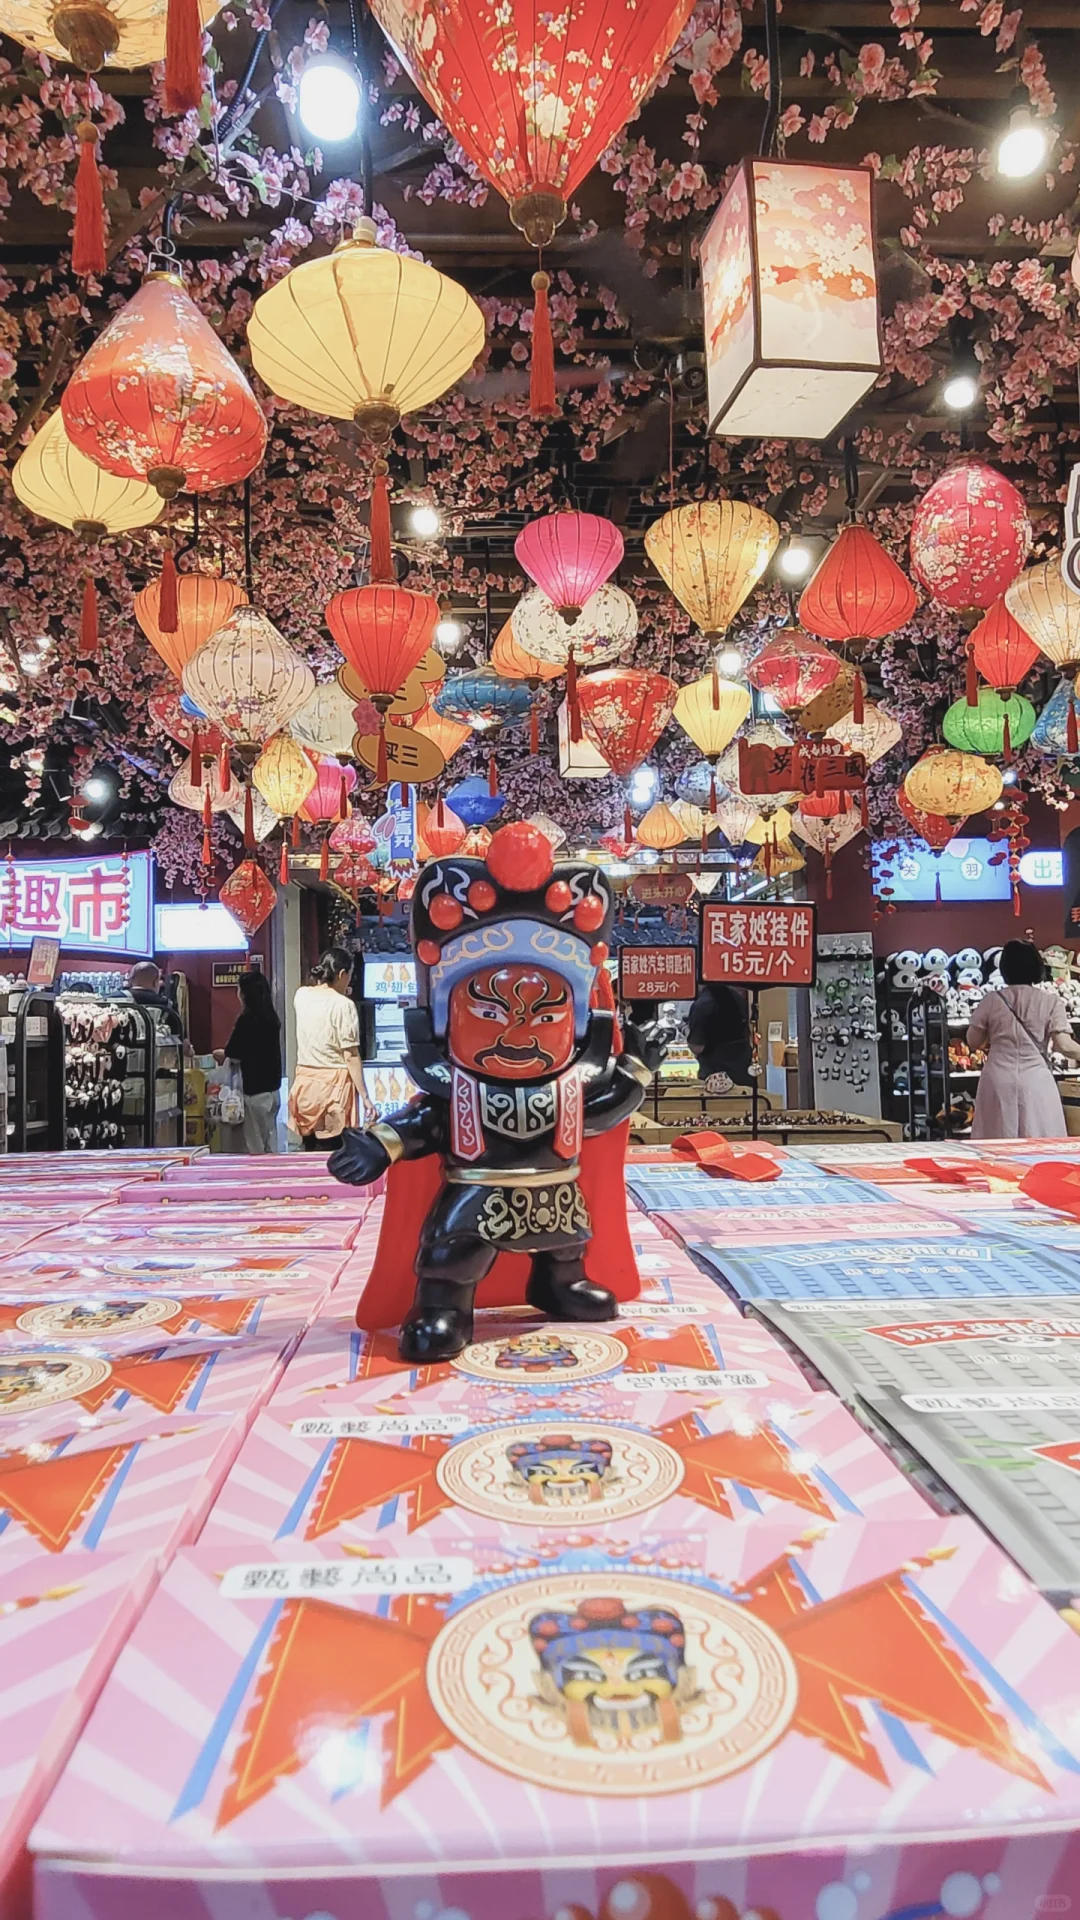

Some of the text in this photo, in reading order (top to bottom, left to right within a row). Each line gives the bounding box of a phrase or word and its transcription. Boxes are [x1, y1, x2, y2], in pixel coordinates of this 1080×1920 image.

[965, 863, 979, 876] 羽
[0, 866, 126, 937] 趣市
[708, 910, 810, 948] 百家姓挂件
[622, 954, 692, 976] 百家姓汽车钥匙扣
[720, 950, 796, 977] 15元/个
[375, 981, 418, 994] 鸡翅包
[637, 980, 681, 994] 28元/个
